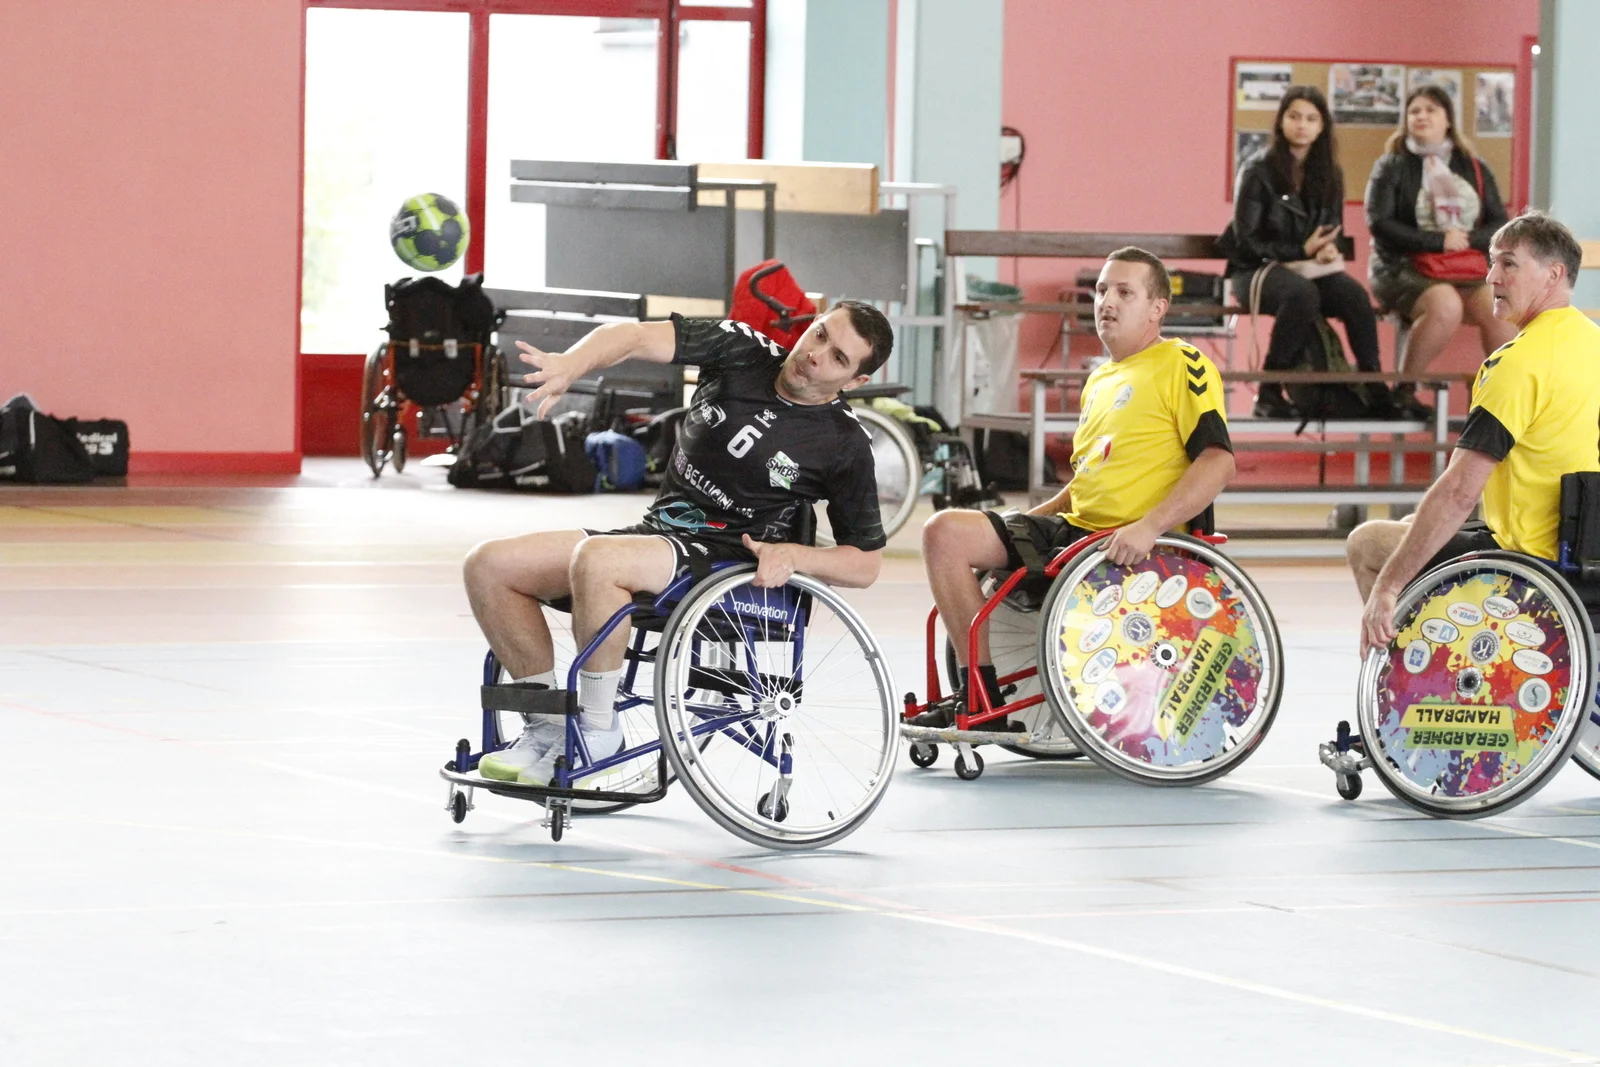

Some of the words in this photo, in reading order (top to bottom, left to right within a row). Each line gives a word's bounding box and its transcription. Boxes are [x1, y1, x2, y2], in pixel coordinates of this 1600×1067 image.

[727, 425, 763, 459] 6
[766, 457, 800, 482] SMEPS
[733, 600, 788, 620] motivation
[1458, 611, 1479, 622] SUPER
[1159, 639, 1213, 720] HANDBALL
[1176, 642, 1233, 736] GERARDMER
[1416, 708, 1501, 724] HANDBALL
[1413, 731, 1510, 747] GERARDMER
